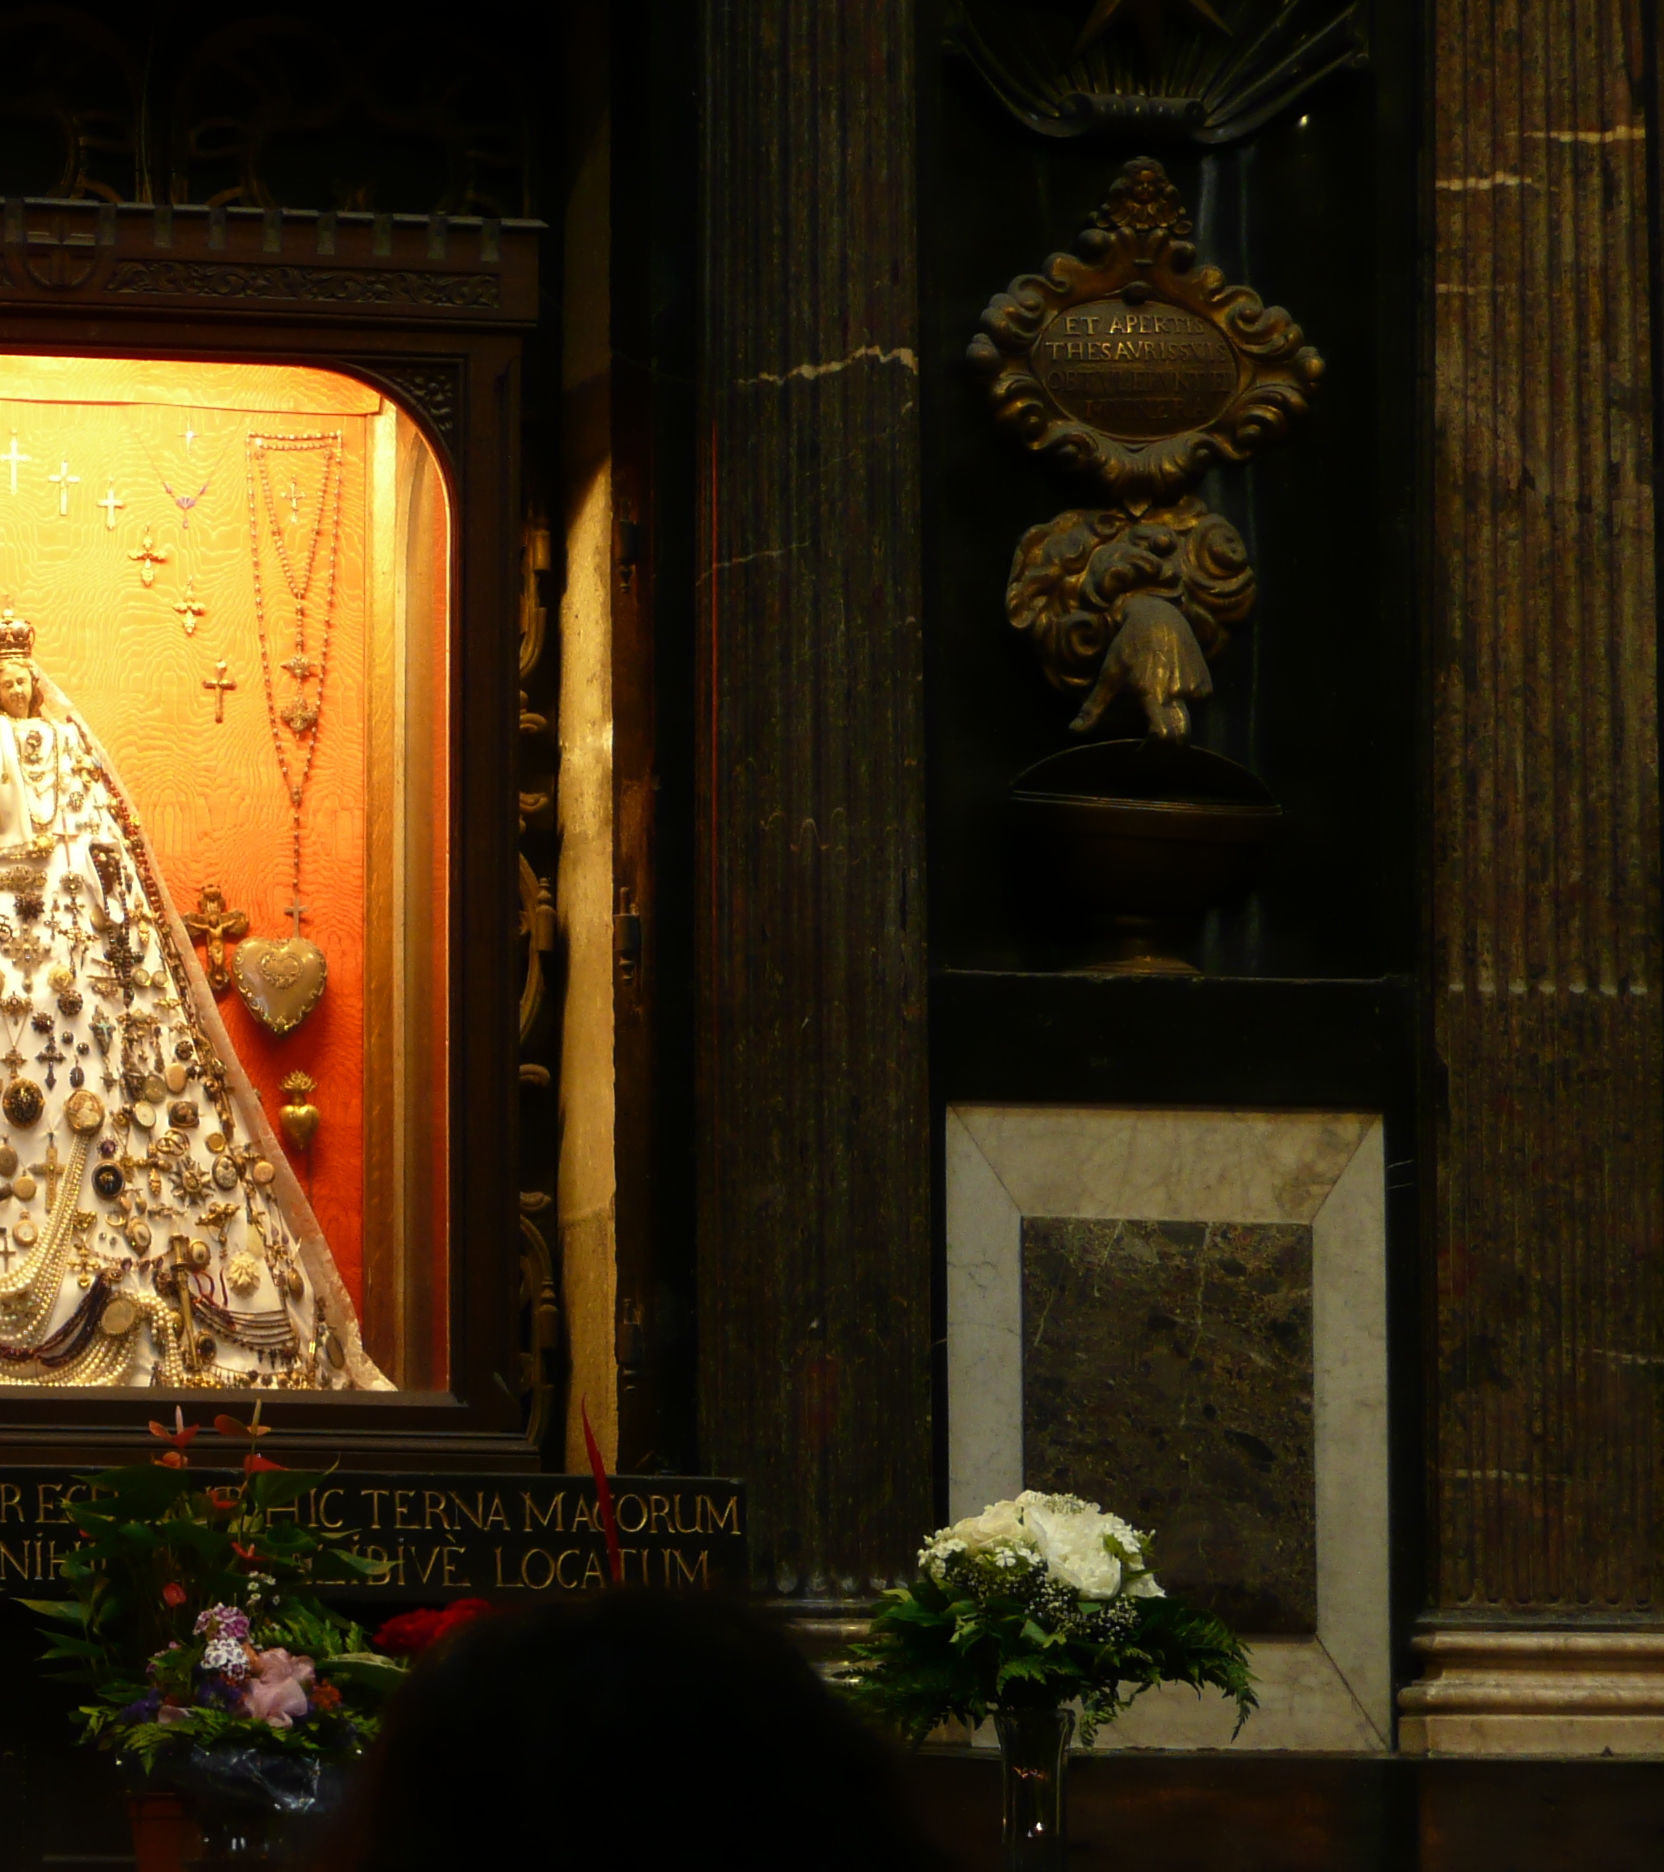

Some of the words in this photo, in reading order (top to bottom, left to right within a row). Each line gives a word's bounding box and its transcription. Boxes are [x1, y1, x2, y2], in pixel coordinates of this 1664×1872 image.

[1063, 316, 1100, 337] ET
[1107, 315, 1206, 336] APERTIS
[361, 1488, 512, 1532] TERNA
